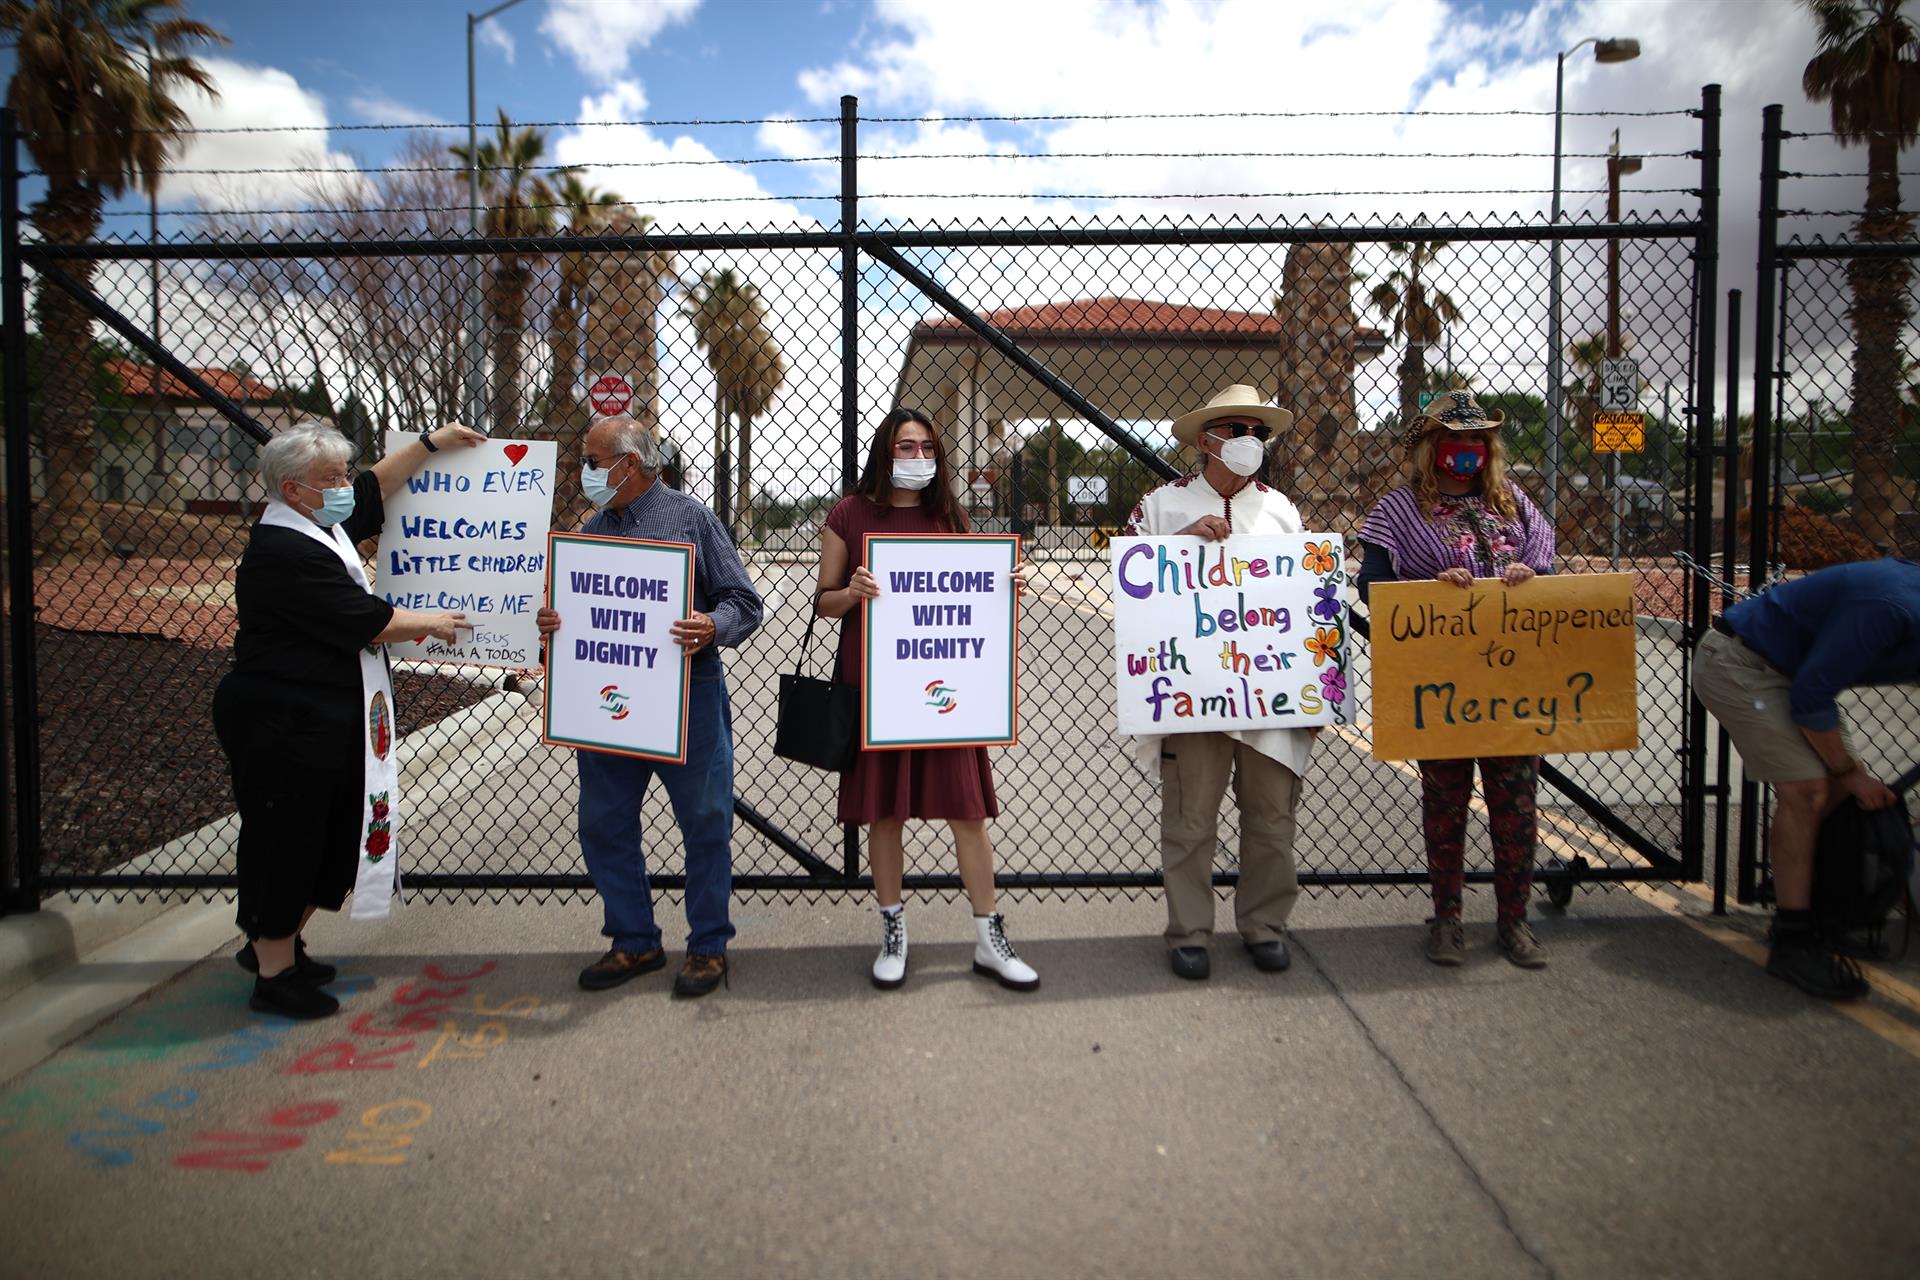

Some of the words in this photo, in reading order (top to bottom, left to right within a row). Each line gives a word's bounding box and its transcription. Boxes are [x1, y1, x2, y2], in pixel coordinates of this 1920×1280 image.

[1609, 386, 1630, 405] 15
[407, 470, 470, 494] WHO
[482, 469, 546, 495] EVER
[1077, 480, 1098, 490] GTE
[1071, 491, 1106, 500] CLOSD
[401, 515, 527, 540] WELCOMES
[468, 552, 545, 574] CHILDREN
[1118, 543, 1294, 600] Children
[570, 571, 669, 602] WELCOME
[889, 571, 995, 593] WELCOME
[500, 594, 533, 615] ME
[912, 604, 972, 626] WITH
[1193, 592, 1292, 639] belong
[590, 607, 646, 634] WITH
[1390, 592, 1485, 642] What
[1501, 591, 1636, 647] happened
[467, 624, 509, 647] JESUS
[470, 647, 481, 660] A
[485, 648, 526, 662] TODOS
[575, 639, 658, 669] DIGNITY
[896, 637, 985, 660] DIGNITY
[1127, 637, 1192, 677] with
[1219, 640, 1297, 676] their
[1479, 640, 1517, 668] to
[1145, 676, 1323, 722] families
